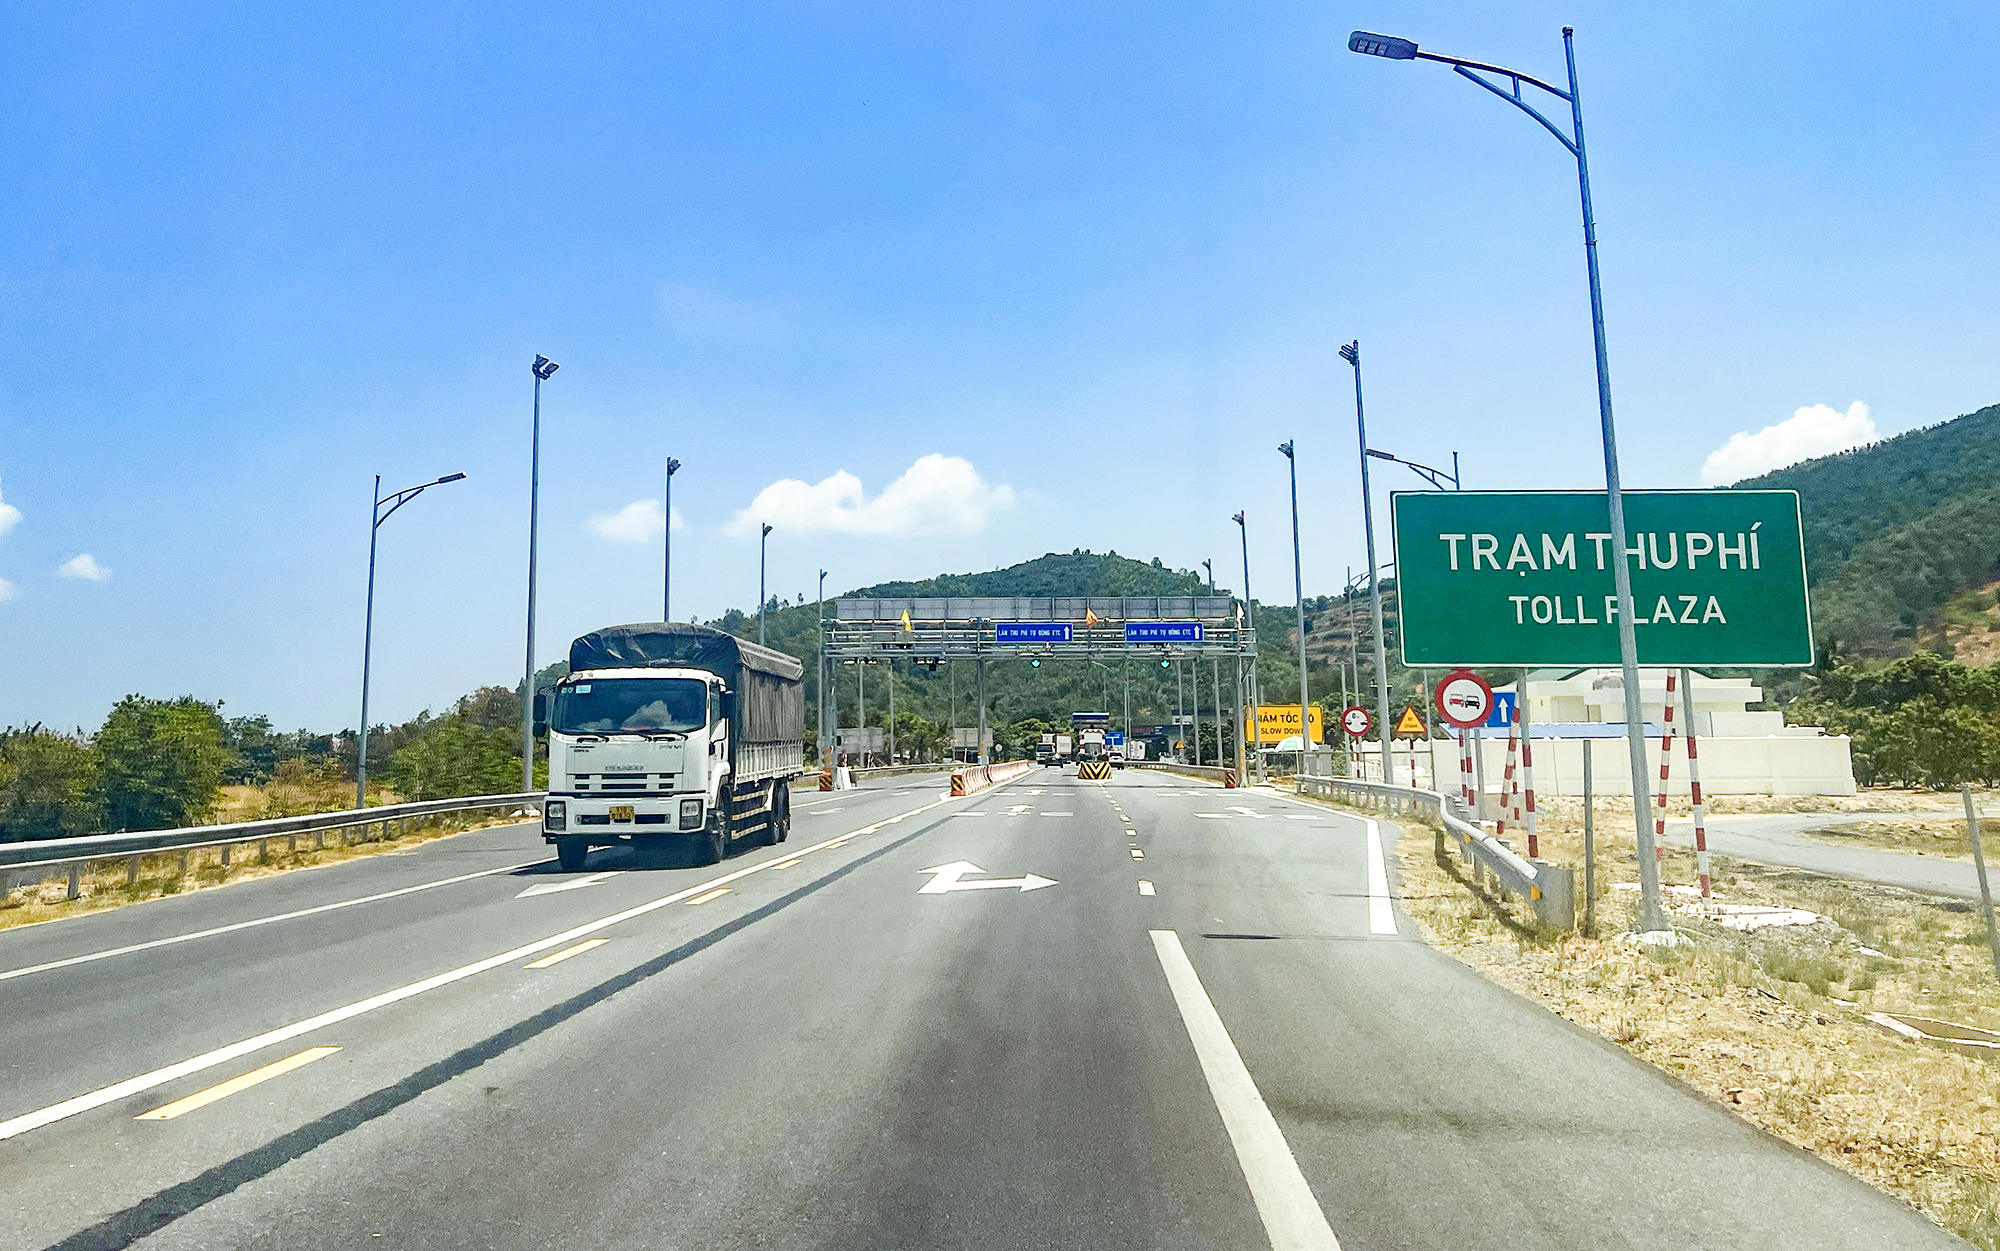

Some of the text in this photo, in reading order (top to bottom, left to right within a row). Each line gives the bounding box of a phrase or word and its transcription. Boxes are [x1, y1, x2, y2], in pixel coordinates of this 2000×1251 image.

[1439, 521, 1762, 577] TRẠM THU PHÍ
[1508, 595, 1727, 625] TOLL PLAZA
[1258, 711, 1277, 723] IẢM
[1280, 710, 1299, 723] TỐC
[1260, 727, 1304, 735] SLOW DOW
